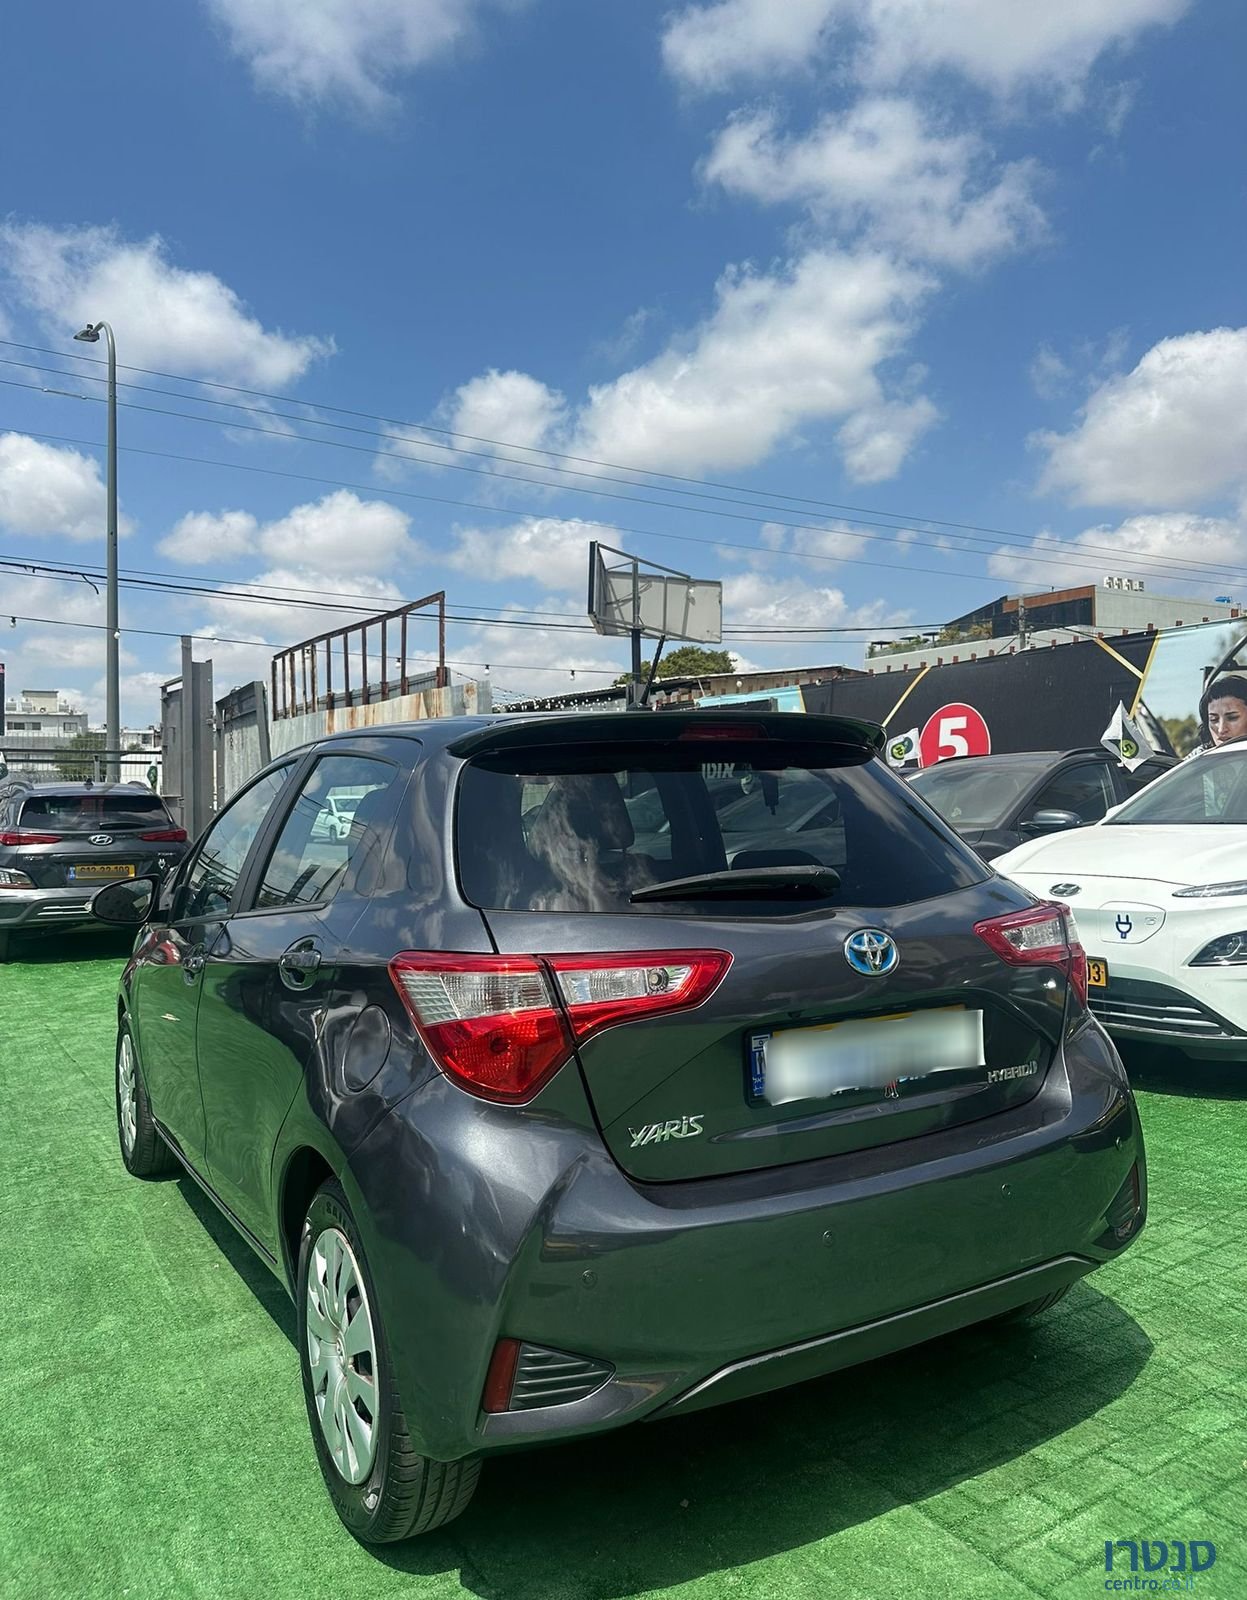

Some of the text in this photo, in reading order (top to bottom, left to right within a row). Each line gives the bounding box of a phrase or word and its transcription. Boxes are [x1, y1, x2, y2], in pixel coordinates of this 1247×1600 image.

[938, 716, 969, 760] 5
[1122, 743, 1133, 753] 5
[987, 1063, 1031, 1083] HYBRID
